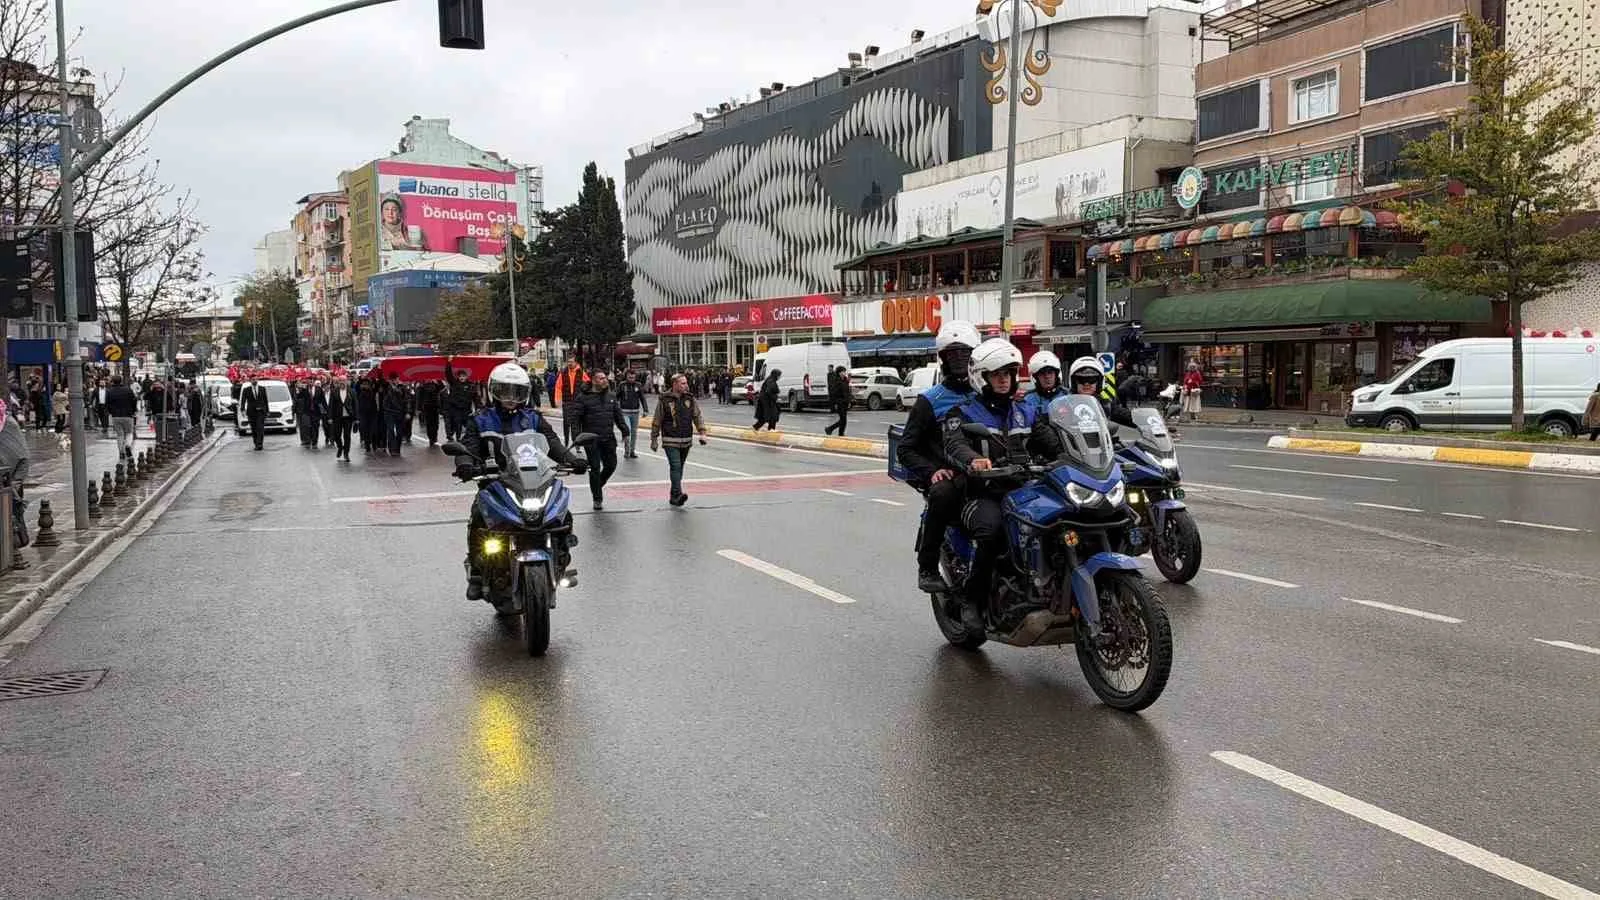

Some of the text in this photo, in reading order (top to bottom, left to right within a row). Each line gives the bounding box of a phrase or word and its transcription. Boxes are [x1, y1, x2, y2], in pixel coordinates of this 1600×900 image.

[1215, 160, 1298, 195] KAHVE
[419, 183, 508, 200] bianca stella
[423, 207, 484, 221] Dönüşüm
[1059, 307, 1086, 320] TERZ
